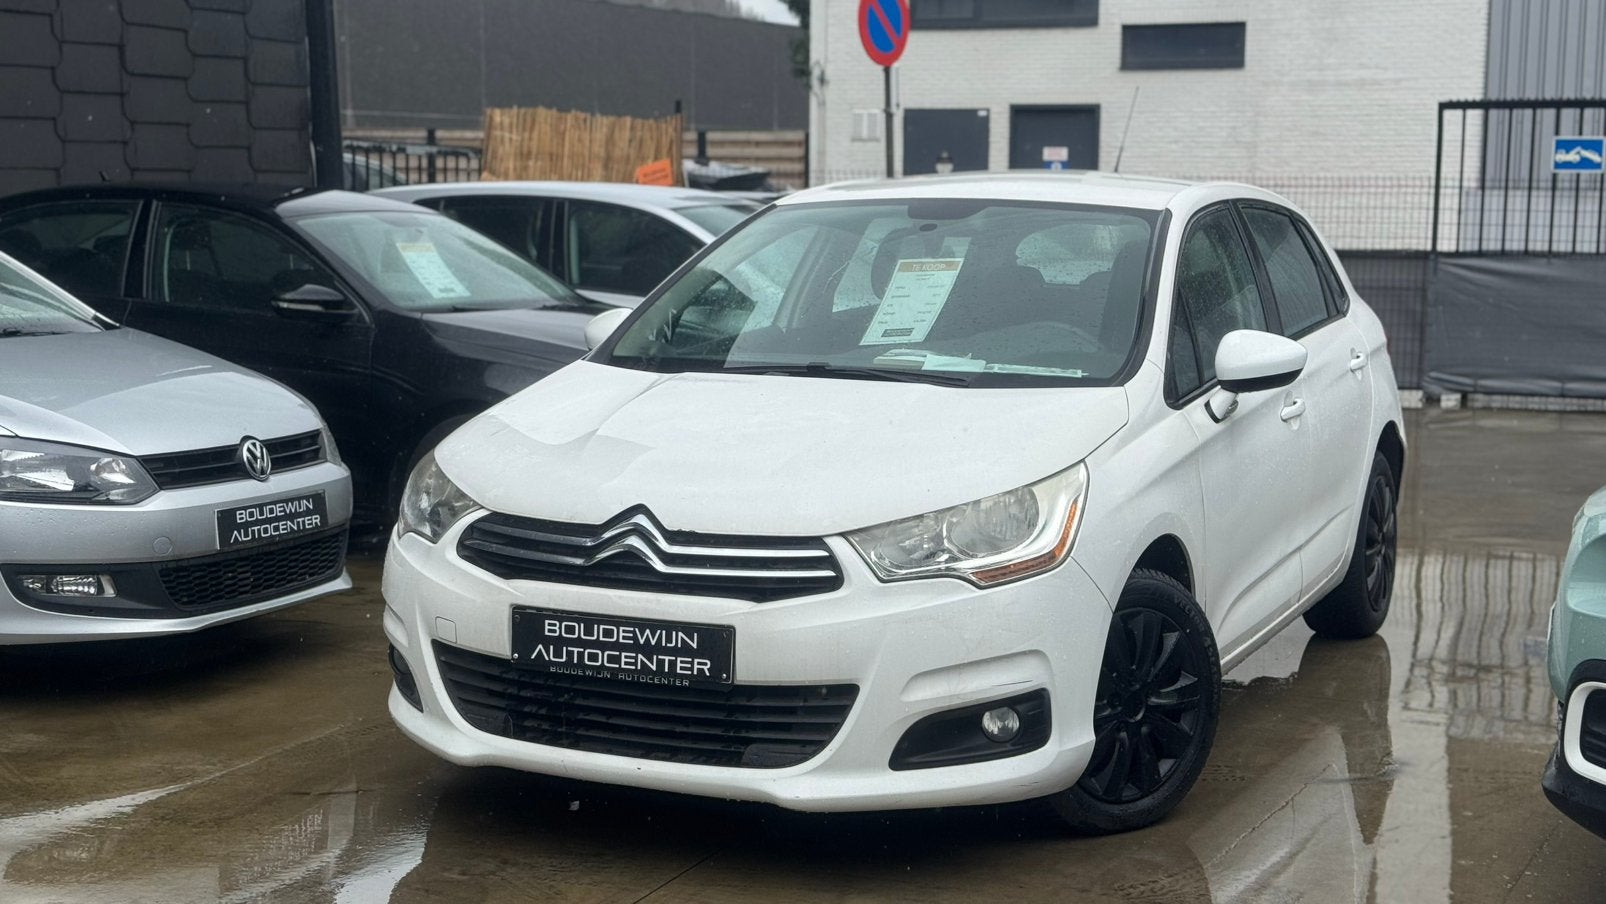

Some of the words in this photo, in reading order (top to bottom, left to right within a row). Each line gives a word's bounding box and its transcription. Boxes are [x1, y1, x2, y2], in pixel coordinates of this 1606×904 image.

[922, 263, 946, 271] KOOP
[236, 498, 313, 523] BOUDEWIJN
[230, 515, 321, 544] AUTOCENTER
[544, 619, 698, 649] BOUDEWIJN
[530, 643, 711, 677] AUTOCENTER
[549, 666, 611, 679] BOUDEWIJN
[618, 672, 690, 687] AUTOCENTER
